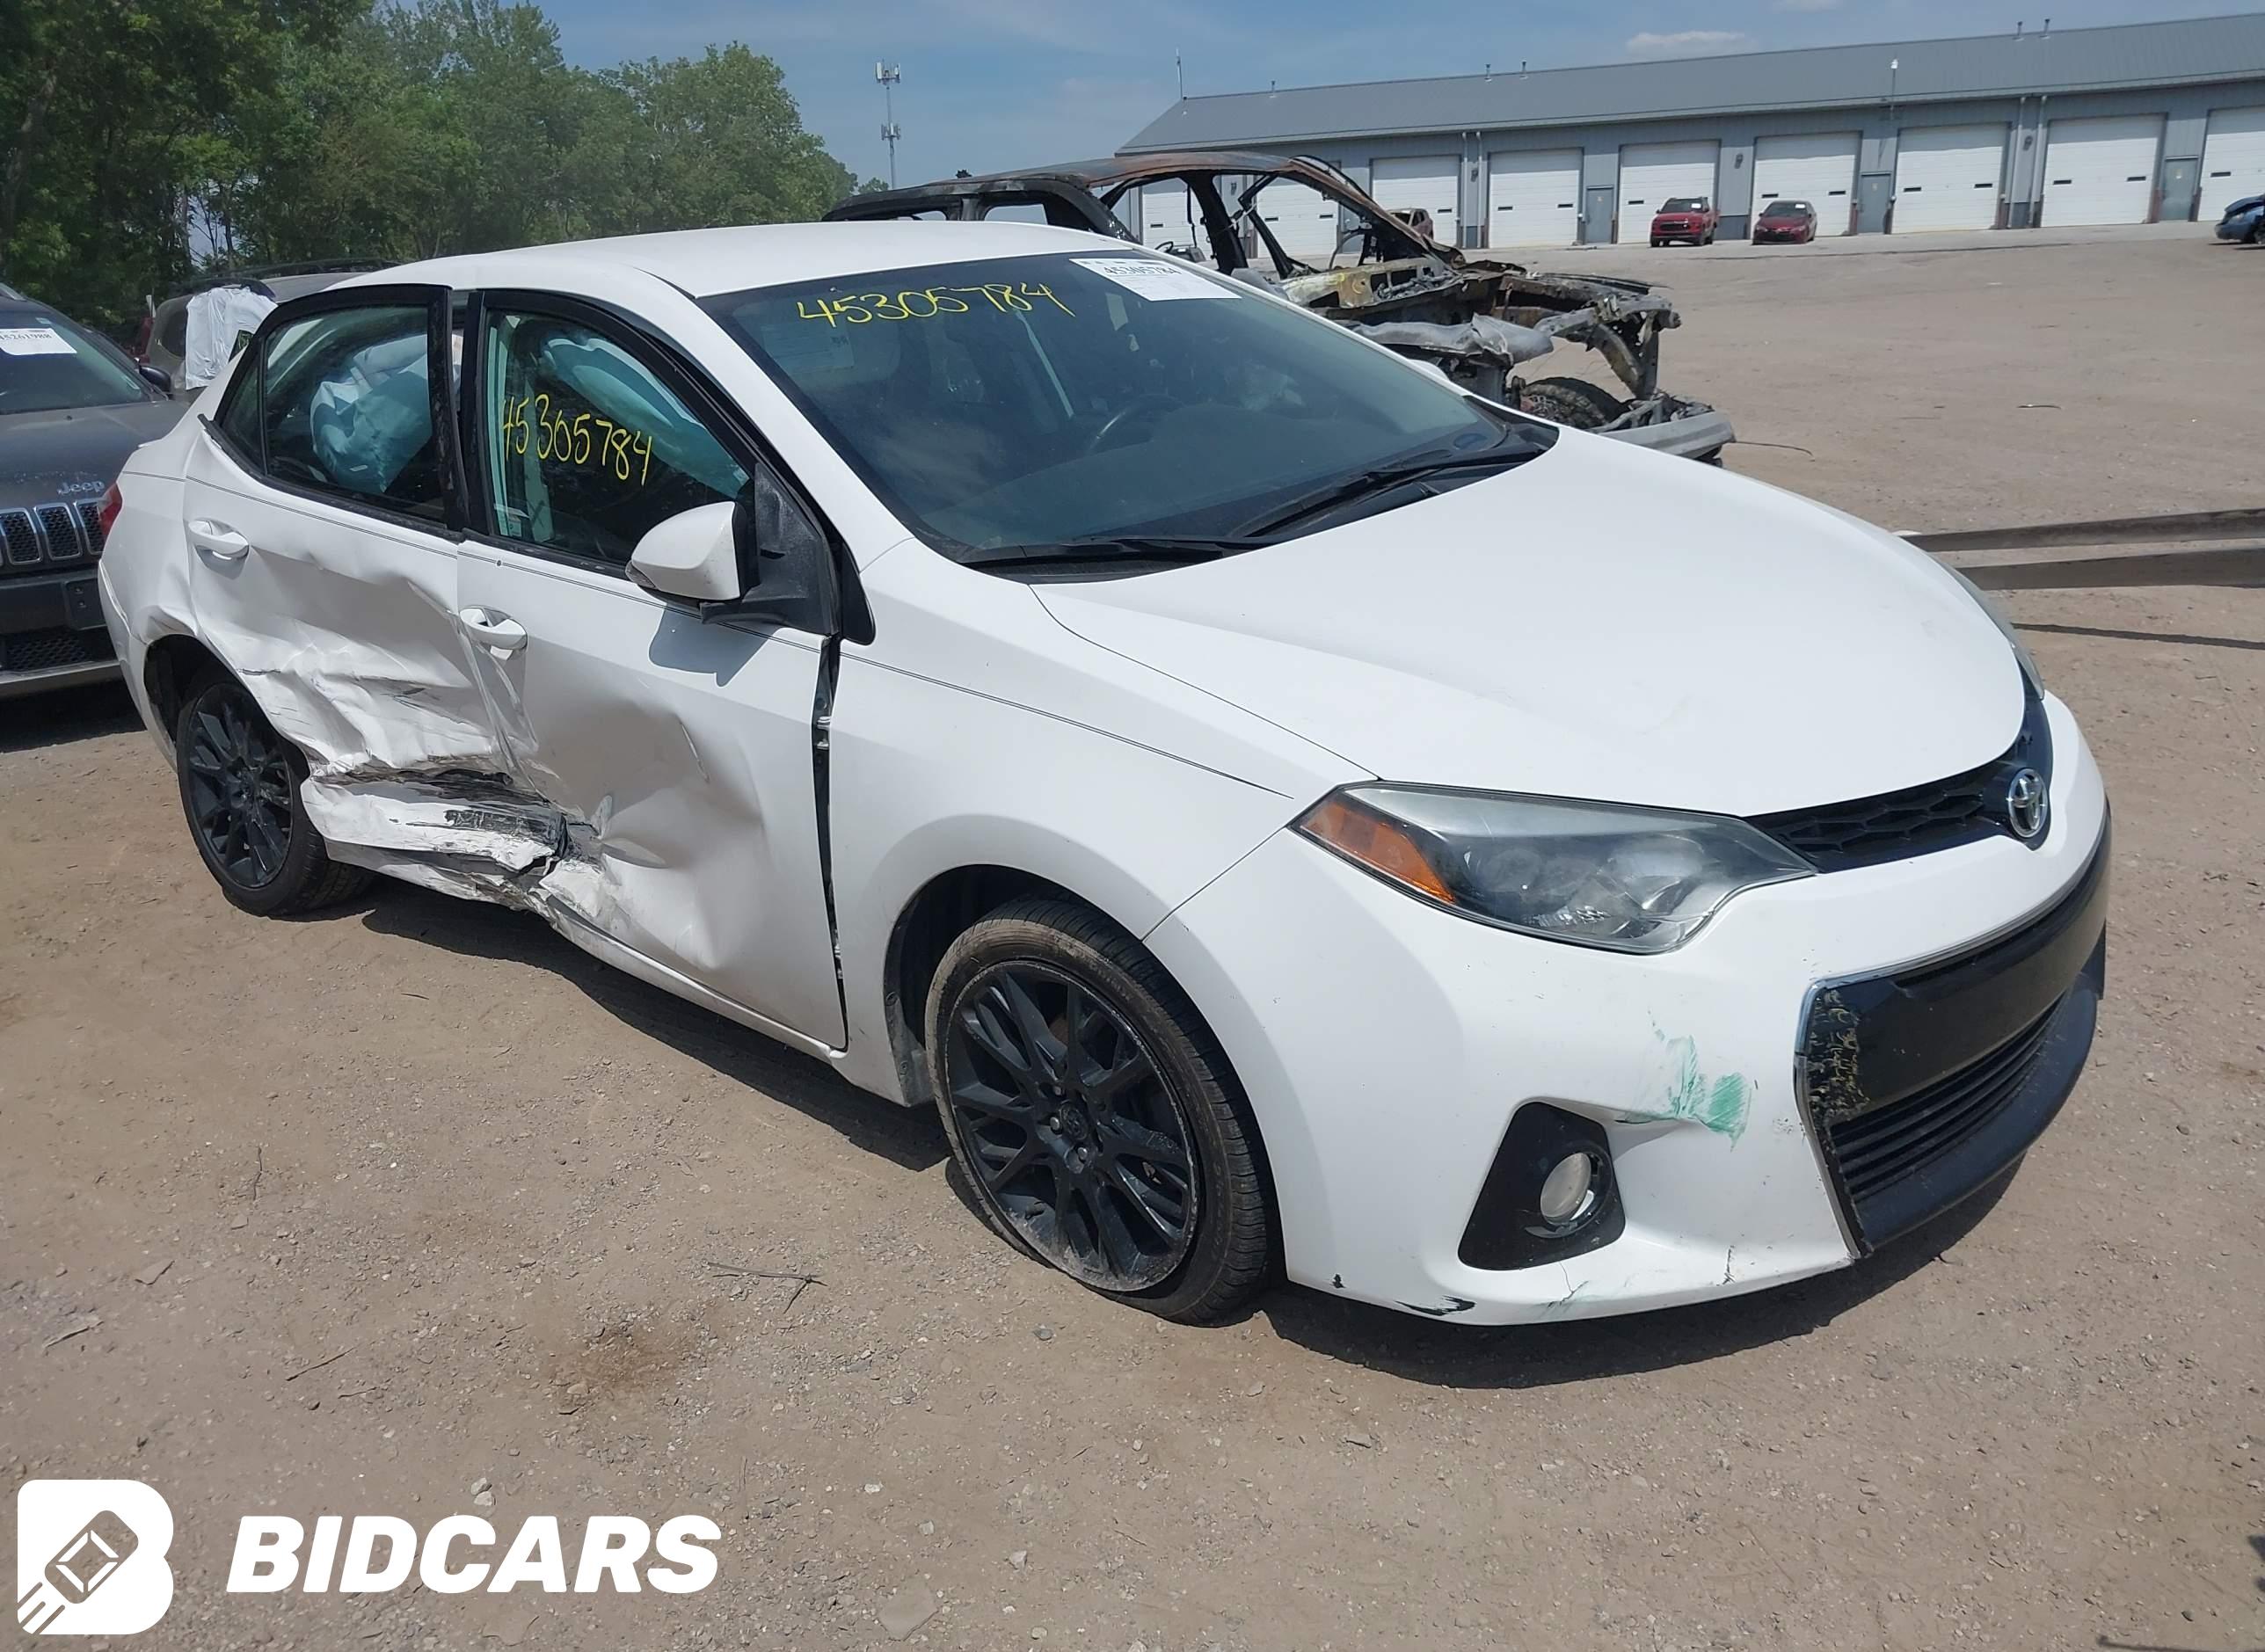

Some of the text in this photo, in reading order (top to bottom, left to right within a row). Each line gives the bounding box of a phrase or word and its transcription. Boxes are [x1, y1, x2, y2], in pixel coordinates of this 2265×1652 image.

[796, 281, 1077, 328] 45305784
[501, 393, 652, 486] 45305784
[57, 481, 105, 495] Jeep
